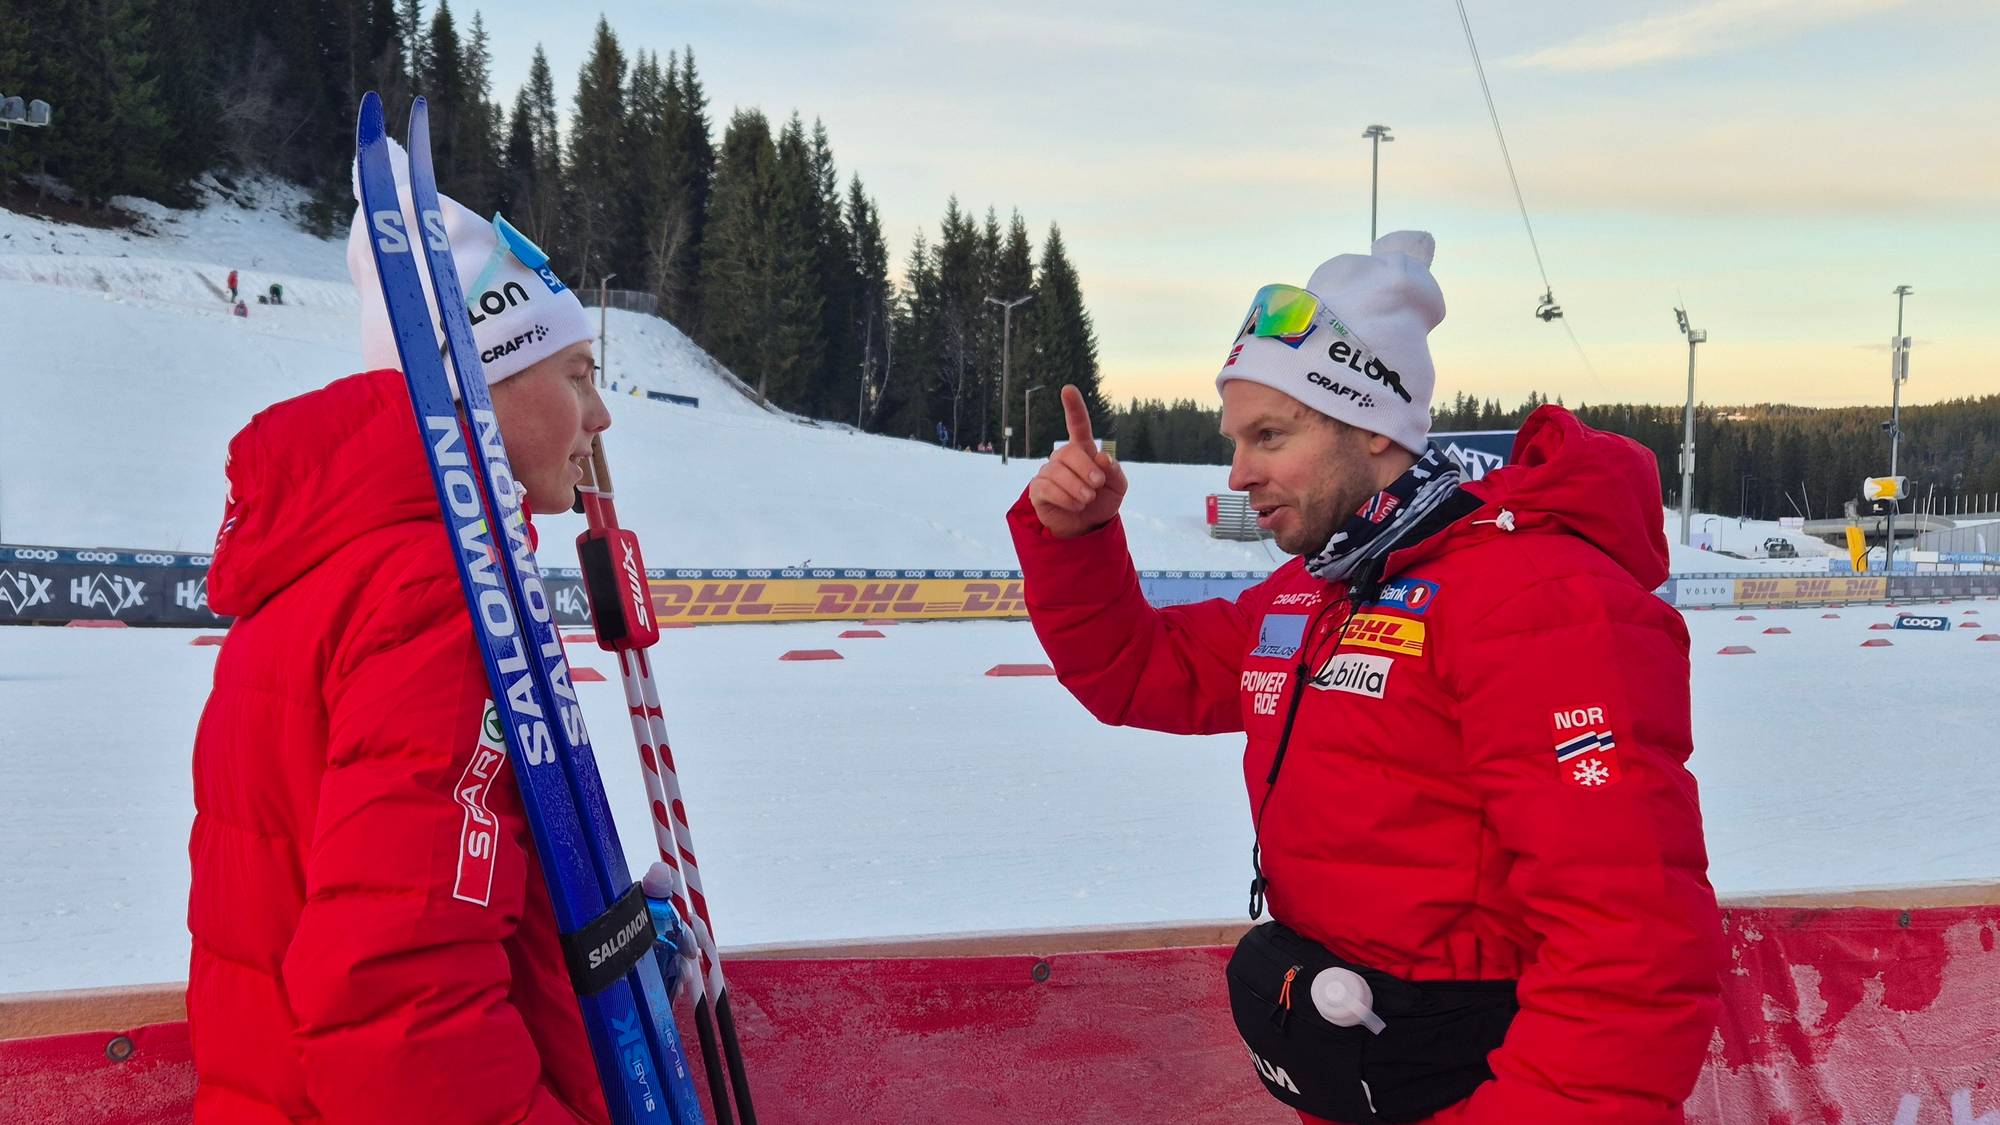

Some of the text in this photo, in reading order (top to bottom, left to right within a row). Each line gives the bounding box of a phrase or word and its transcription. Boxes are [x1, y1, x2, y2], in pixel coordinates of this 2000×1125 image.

[373, 211, 409, 253] S
[422, 210, 450, 251] S
[481, 331, 533, 364] CRAFT
[1307, 371, 1361, 401] CRAFT
[15, 549, 58, 562] coop
[76, 552, 118, 564] coop
[135, 554, 175, 566] coop
[472, 408, 590, 749] SALOMON
[676, 570, 702, 579] coop
[712, 570, 737, 579] coop
[747, 570, 772, 579] coop
[781, 570, 804, 579] coop
[813, 570, 835, 579] coop
[844, 570, 866, 579] coop
[875, 570, 897, 579] coop
[905, 570, 926, 579] coop
[934, 570, 955, 579] coop
[963, 570, 983, 579] coop
[990, 570, 1010, 579] coop
[425, 414, 556, 767] SALOMON
[1741, 581, 1780, 599] DHL
[1795, 580, 1832, 598] DHL
[1846, 580, 1880, 596] DHL
[650, 584, 774, 616] DHL
[815, 584, 925, 614] DHL
[961, 583, 1027, 611] DH
[1272, 593, 1313, 605] CRAFT
[1902, 618, 1943, 628] coop
[1344, 619, 1405, 647] DHL
[1240, 671, 1288, 693] POWER
[1333, 661, 1384, 694] bilia
[1253, 693, 1280, 715] ADE
[1553, 706, 1605, 730] NOR
[588, 906, 649, 970] SALOMON
